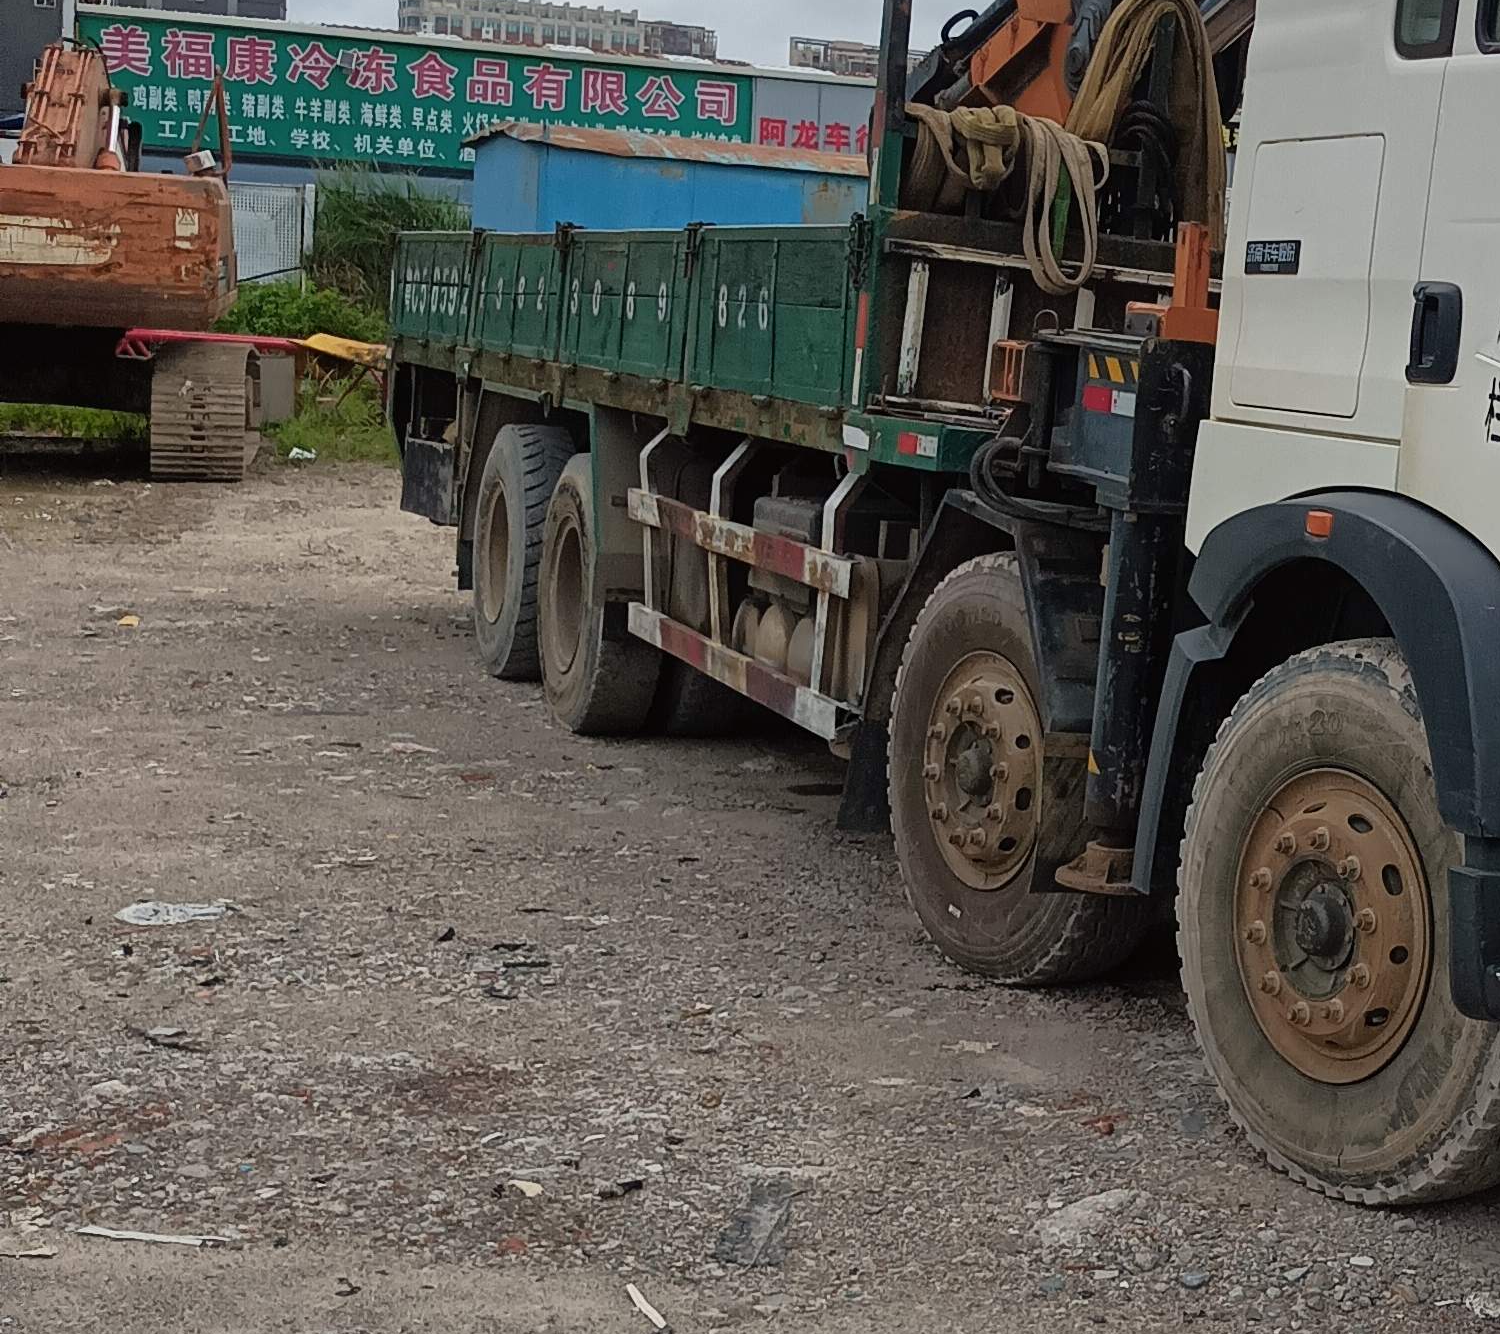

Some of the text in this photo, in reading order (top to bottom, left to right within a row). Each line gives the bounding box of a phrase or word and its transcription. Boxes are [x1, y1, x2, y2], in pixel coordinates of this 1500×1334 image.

[99, 23, 739, 127] 美福康冷冻食品有限公司
